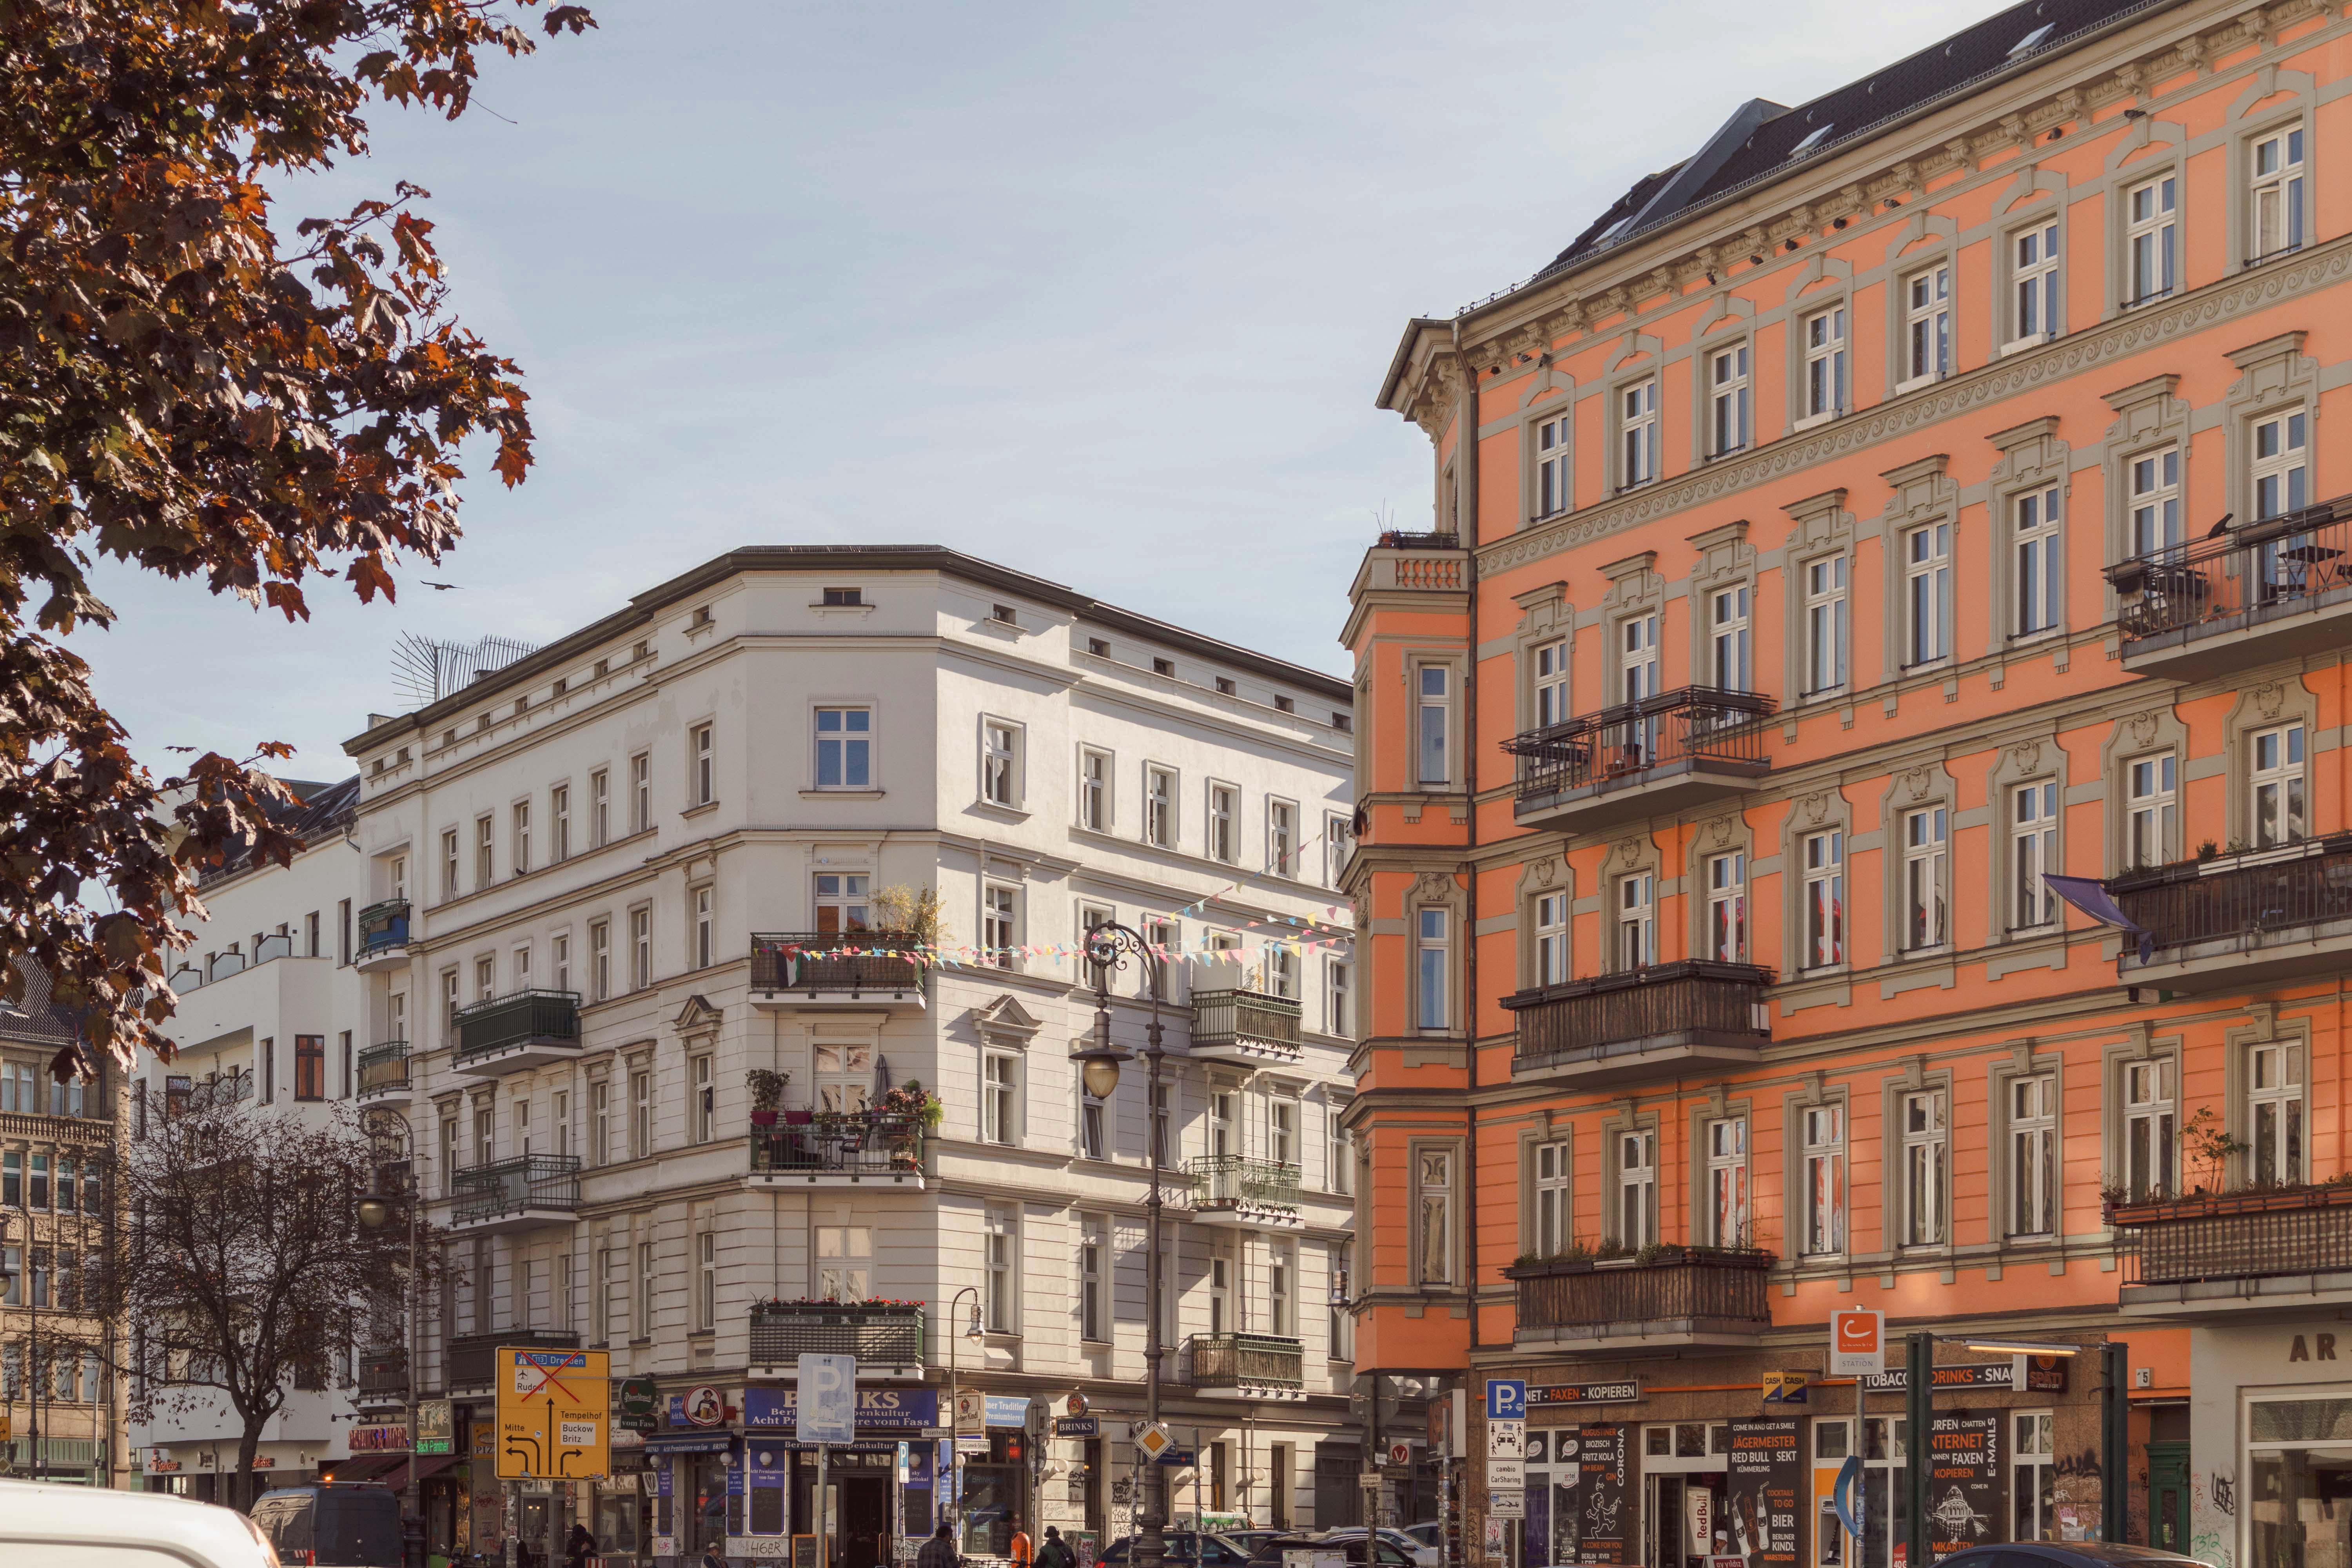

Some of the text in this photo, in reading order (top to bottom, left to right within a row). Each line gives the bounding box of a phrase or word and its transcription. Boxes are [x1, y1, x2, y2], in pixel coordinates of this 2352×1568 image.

[550, 1356, 583, 1365] Dreden
[2029, 1371, 2063, 1386] SPÄTI
[2143, 1372, 2148, 1383] 5
[811, 1365, 841, 1416] P
[1550, 1388, 1580, 1401] FAXEN
[1588, 1385, 1634, 1399] KOPIEREN
[1496, 1385, 1516, 1414] P
[561, 1411, 602, 1420] Tempelhof
[752, 1416, 779, 1424] Acht
[968, 1410, 978, 1419] Kindl
[985, 1412, 1020, 1421] Premiumbiere
[1059, 1422, 1092, 1431] BRINKS
[1581, 1428, 1616, 1436] AUGUSTINER
[430, 1440, 449, 1452] Panther
[1732, 1435, 1796, 1449] JÄGERMEISTER
[1987, 1417, 1996, 1477] E-MAILS
[901, 1445, 906, 1465] P
[1582, 1452, 1615, 1461] FRITZ KOLA
[1731, 1451, 1797, 1463] RED BULL SEKT
[1952, 1452, 1984, 1465] FAXEN
[158, 1460, 178, 1472] Sparkasse
[1606, 1472, 1616, 1481] GIN
[1935, 1468, 1974, 1478] KOPIEREN
[972, 1475, 996, 1484] BRINKS
[1774, 1499, 1794, 1508] TO GO
[1696, 1495, 1707, 1539] Red Bull
[1772, 1514, 1794, 1527] BIER
[1772, 1541, 1795, 1551] KINDL
